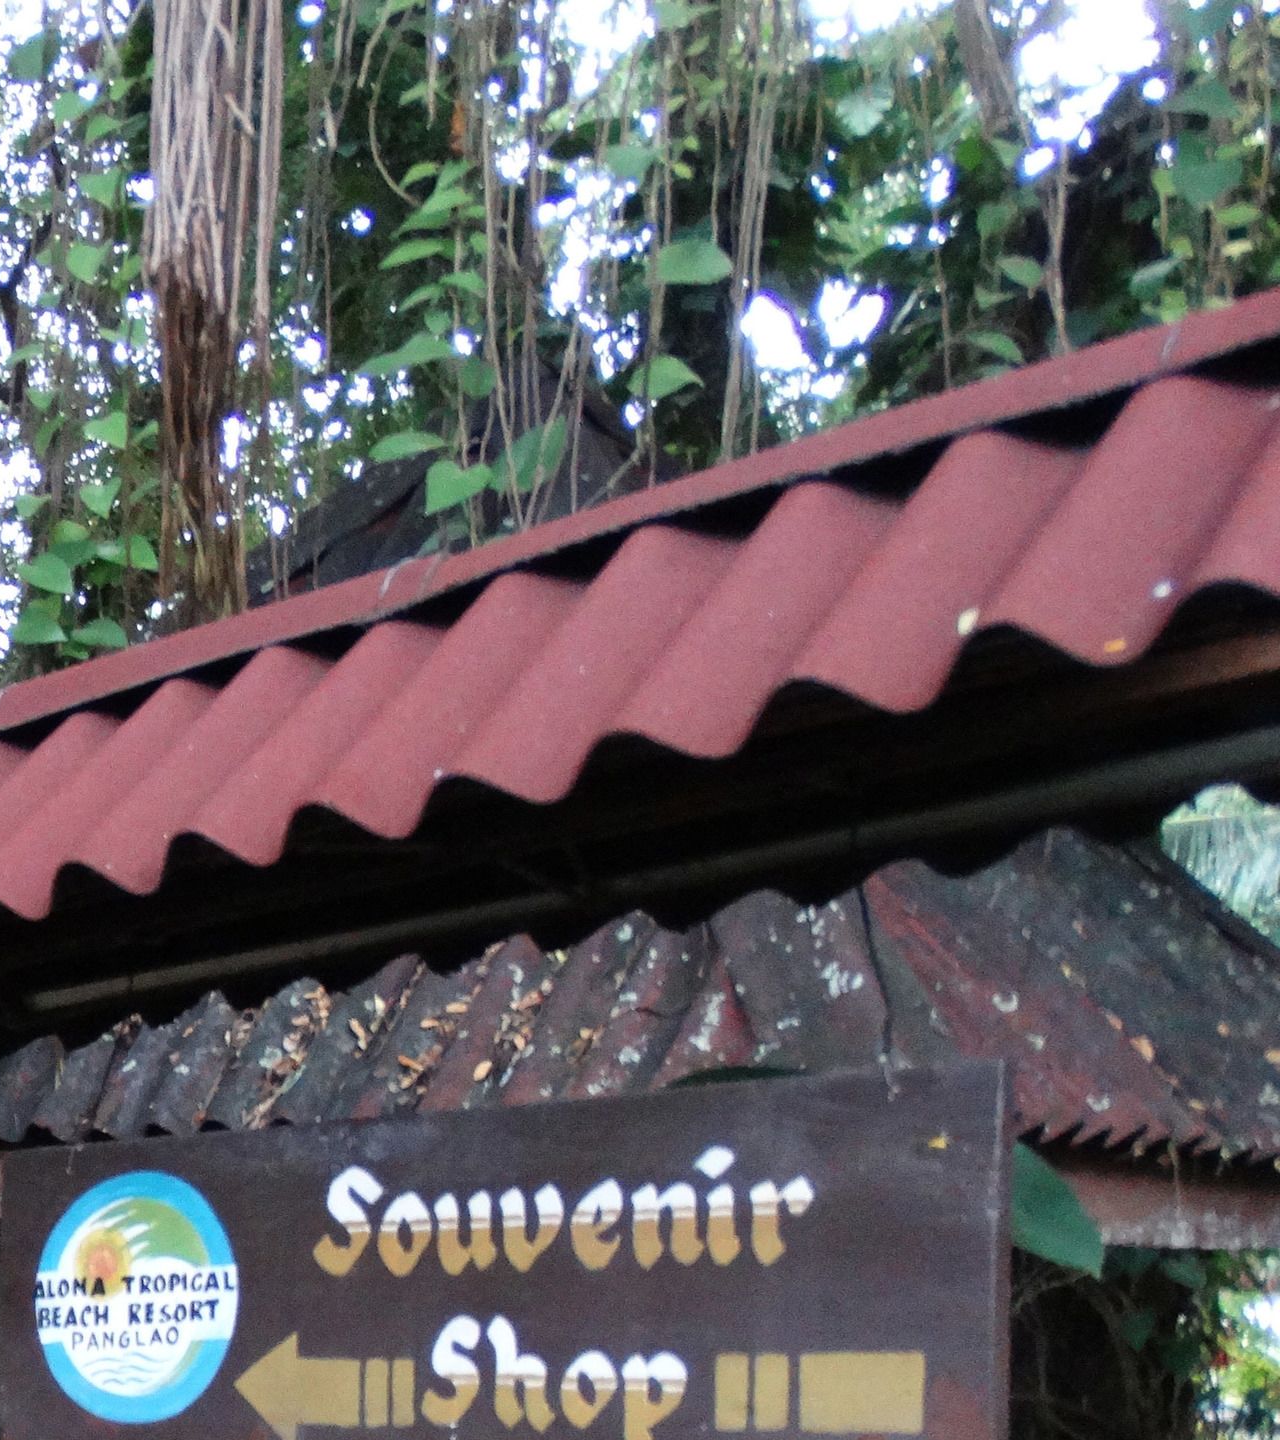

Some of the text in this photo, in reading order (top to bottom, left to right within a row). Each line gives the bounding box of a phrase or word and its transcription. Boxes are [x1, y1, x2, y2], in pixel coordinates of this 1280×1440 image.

[312, 1145, 813, 1277] Souvenir
[34, 1270, 235, 1299] ALONA TROPICAL
[38, 1299, 219, 1329] BEACH RESORT
[72, 1326, 180, 1351] PANGLAO
